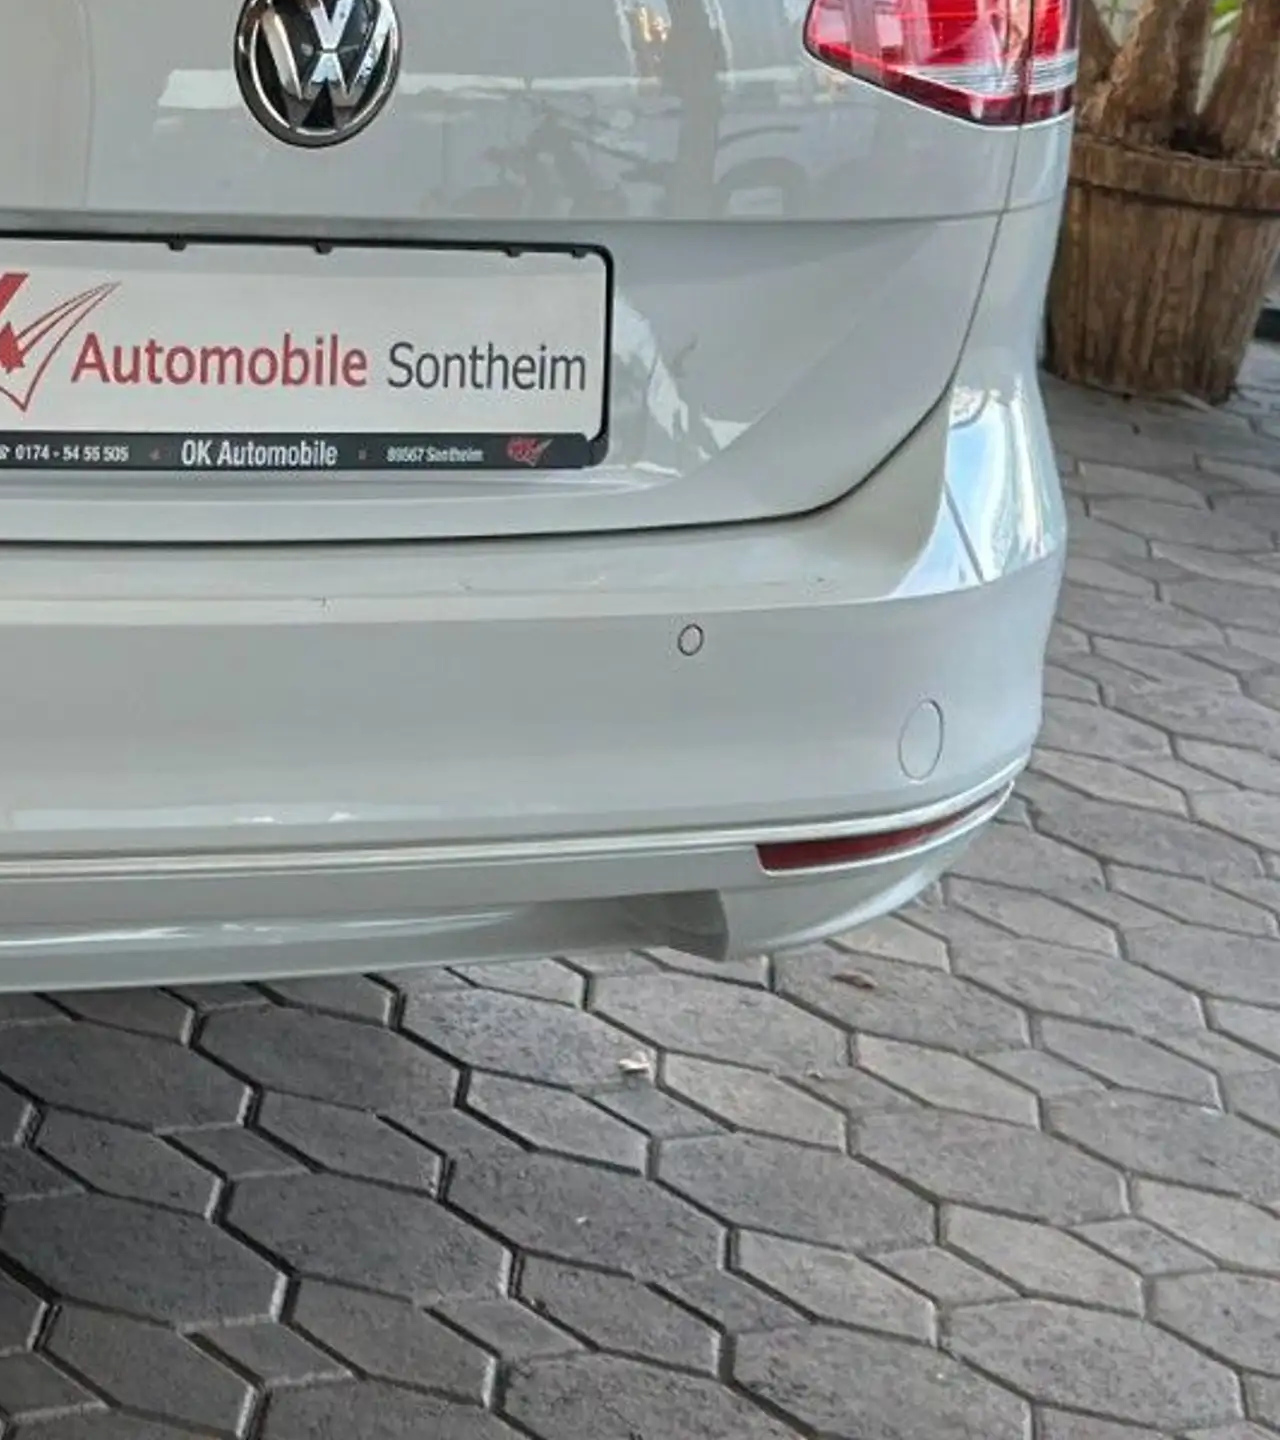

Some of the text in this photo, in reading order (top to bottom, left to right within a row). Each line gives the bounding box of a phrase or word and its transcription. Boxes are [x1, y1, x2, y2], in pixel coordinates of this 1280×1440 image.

[71, 332, 587, 391] Automobile Sontheim
[15, 444, 50, 461] 0174
[62, 445, 80, 461] 54
[103, 445, 130, 463] 505
[181, 439, 339, 468] OK Automobile
